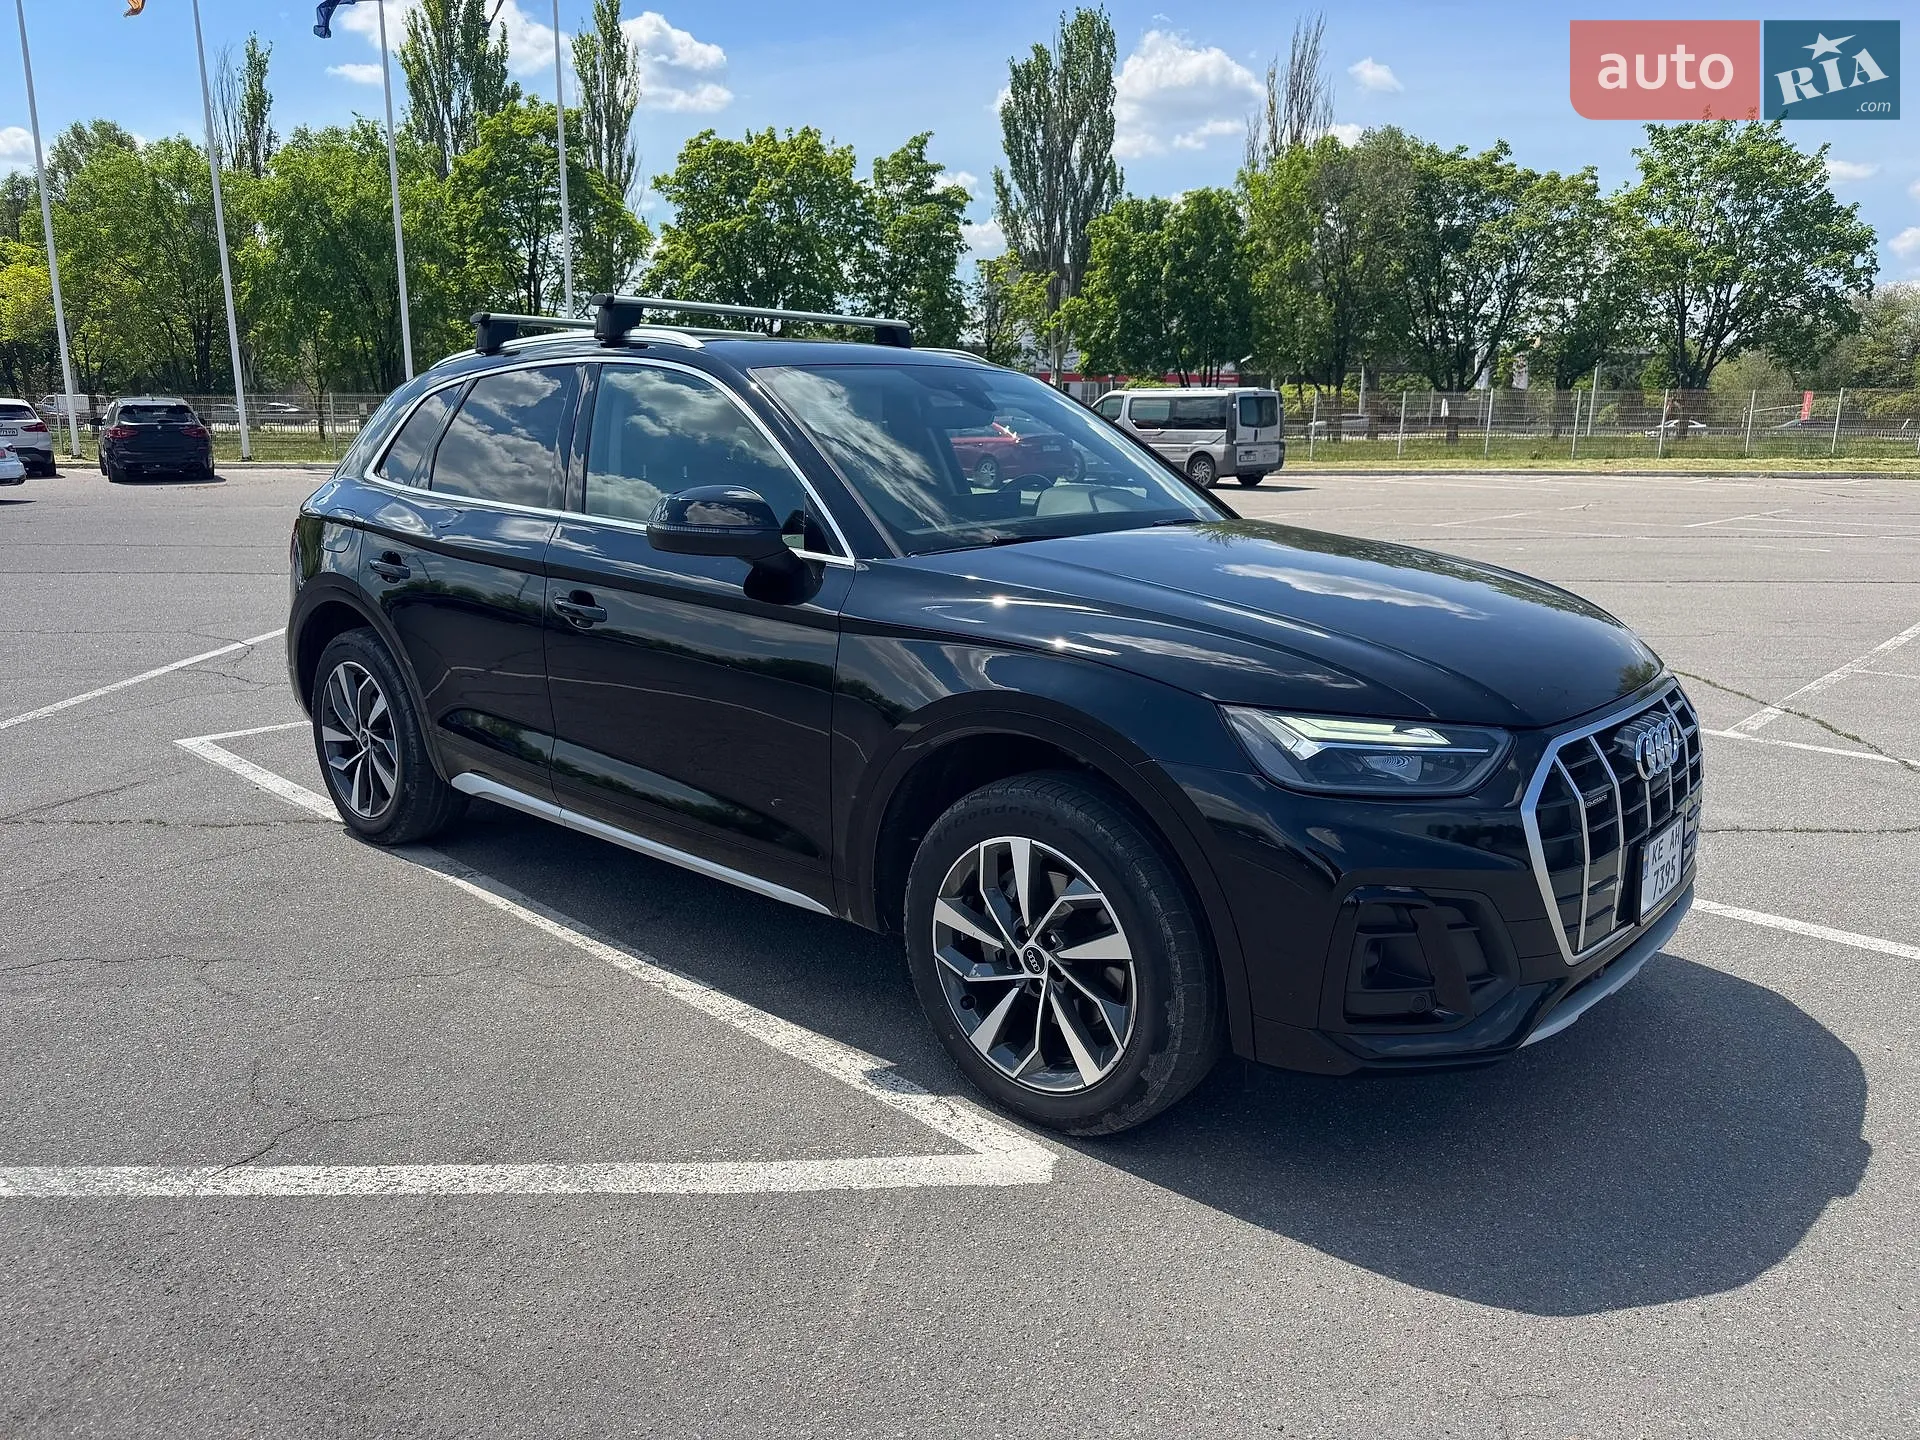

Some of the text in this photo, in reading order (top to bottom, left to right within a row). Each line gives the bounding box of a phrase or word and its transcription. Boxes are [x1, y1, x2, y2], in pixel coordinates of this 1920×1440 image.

[1652, 824, 1681, 866] KE AH
[1653, 854, 1676, 900] 7395
